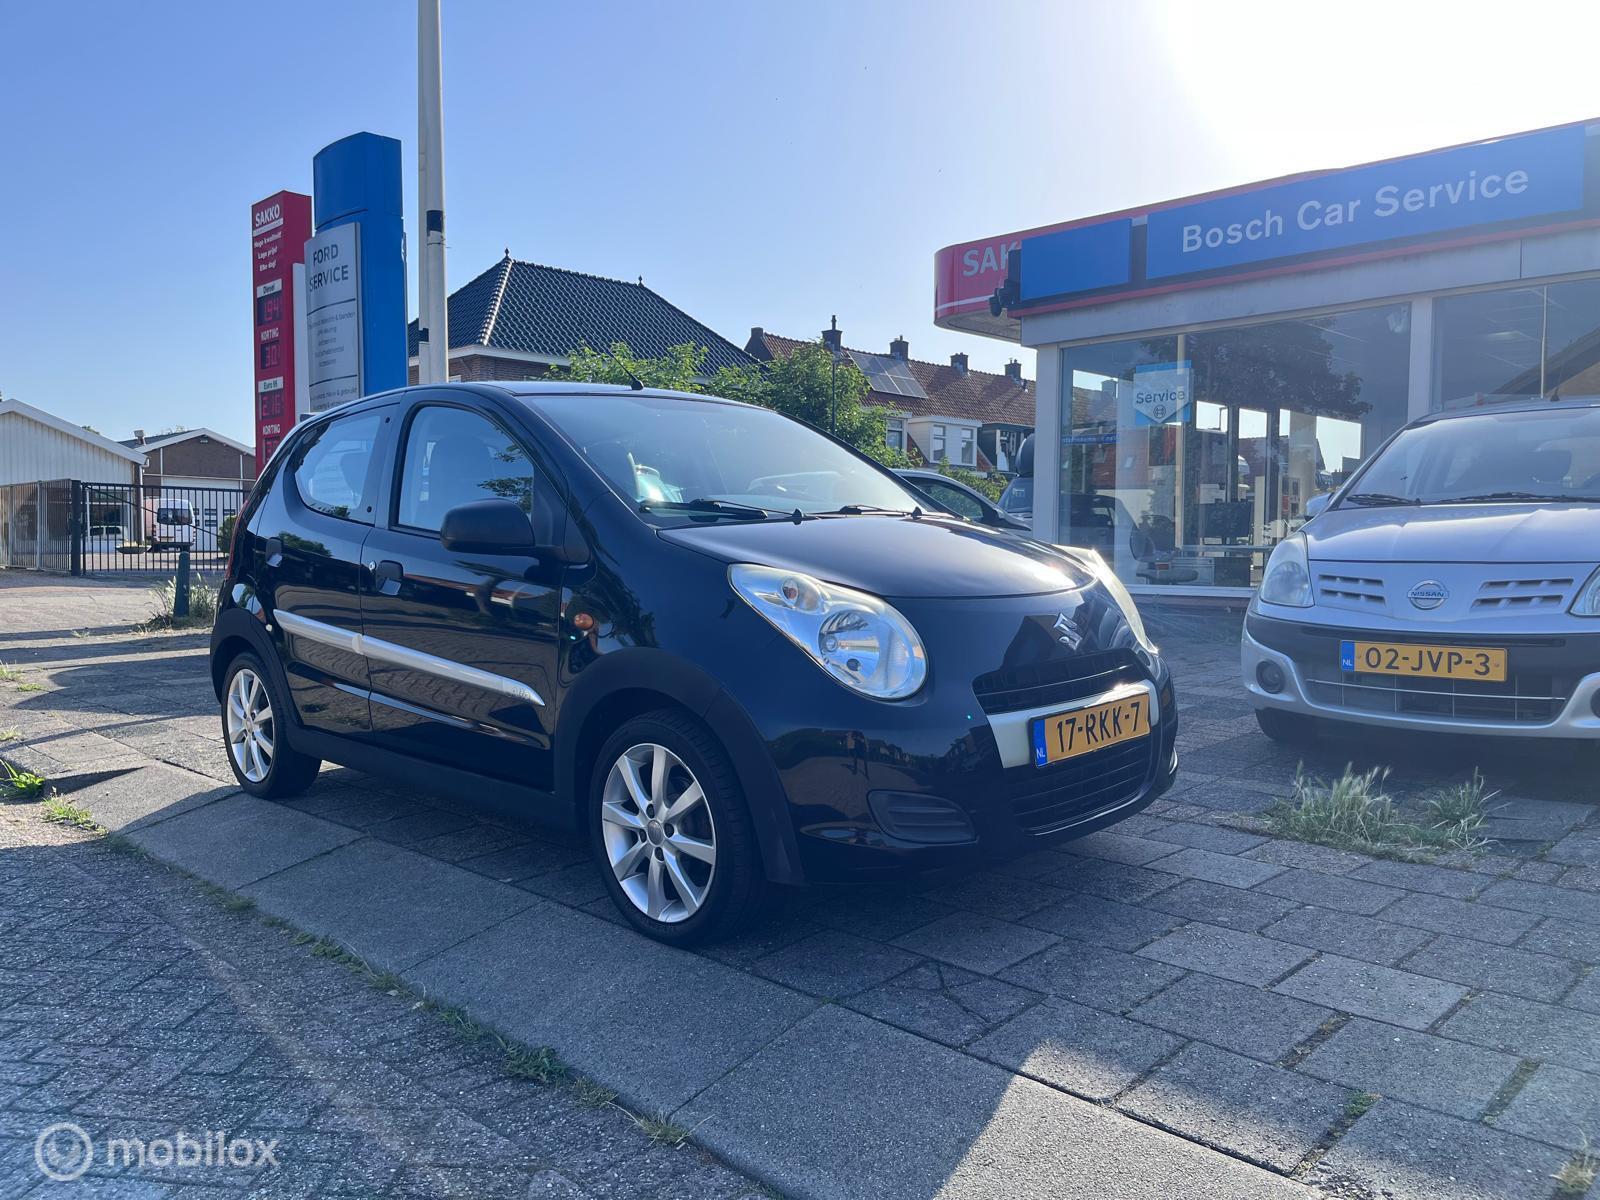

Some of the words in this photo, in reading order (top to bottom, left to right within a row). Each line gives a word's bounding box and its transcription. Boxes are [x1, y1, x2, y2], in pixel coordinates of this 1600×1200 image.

[255, 204, 280, 228] SAKKO
[1182, 209, 1283, 253] Bosch
[1297, 198, 1360, 231] Car
[1374, 170, 1529, 217] Service
[313, 244, 339, 267] FORD
[309, 264, 349, 292] SERVICE
[261, 327, 279, 341] KORTING
[1136, 388, 1186, 405] Service
[262, 423, 280, 436] KORTING
[1410, 590, 1445, 598] NISSAN
[1342, 658, 1353, 667] NL
[1365, 647, 1491, 676] 02-JVP-3
[1056, 701, 1141, 753] 17-RKK-7
[1036, 746, 1046, 759] NL
